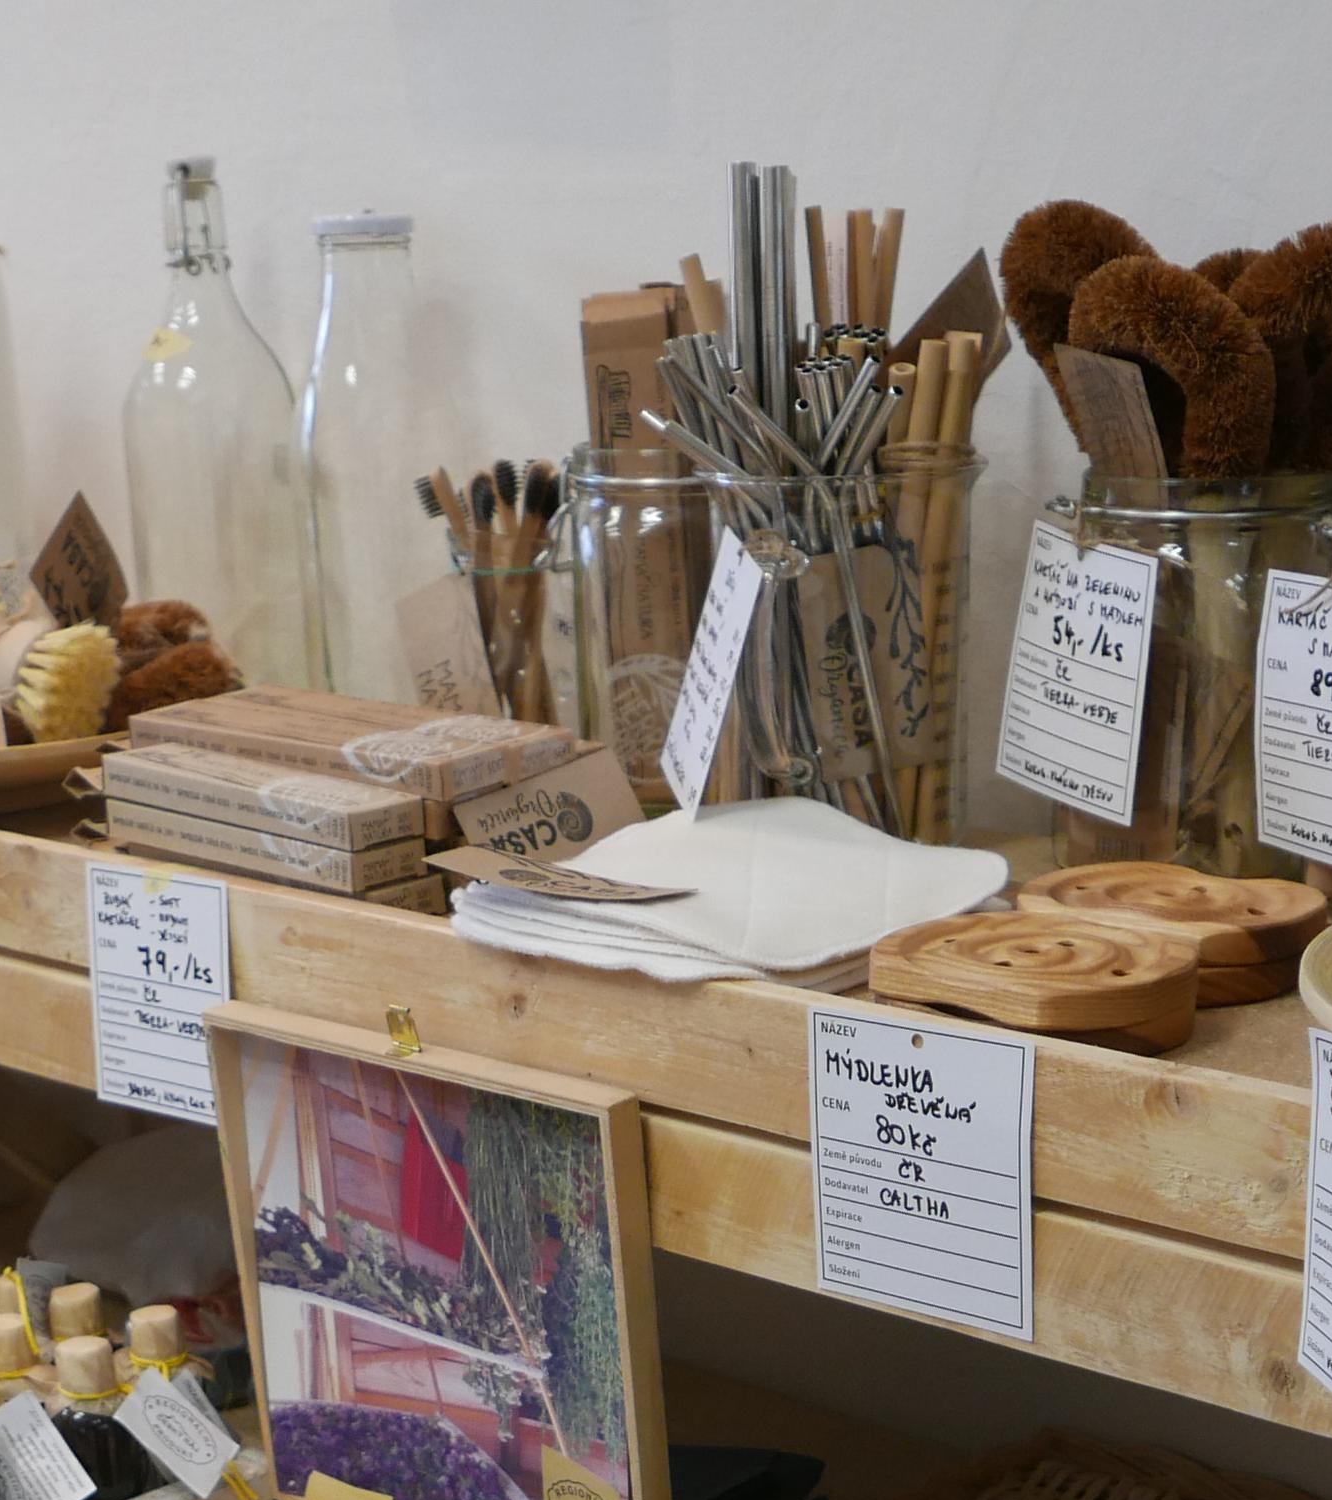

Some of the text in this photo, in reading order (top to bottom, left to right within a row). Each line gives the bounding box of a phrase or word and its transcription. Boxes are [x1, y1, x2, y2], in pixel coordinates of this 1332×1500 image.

[1276, 585, 1302, 600] NÁZEV
[1278, 601, 1332, 630] KARTÁČ
[1308, 638, 1318, 655] S
[1266, 657, 1288, 672] CENA
[821, 1021, 857, 1038] NÁZEV
[826, 1048, 934, 1093] MÝDLENKA
[822, 1096, 850, 1112] CENA
[884, 1092, 977, 1123] DŘEVĚNÁ
[875, 1115, 905, 1145] 80
[823, 1147, 882, 1169] Země původu
[898, 1157, 926, 1183] ČR
[824, 1177, 869, 1194] Dodavatel
[879, 1187, 950, 1220] CALTHA
[1316, 1197, 1332, 1217] Země
[826, 1206, 863, 1223] Expirace
[827, 1235, 861, 1251] Alergen
[828, 1263, 861, 1279] Složení
